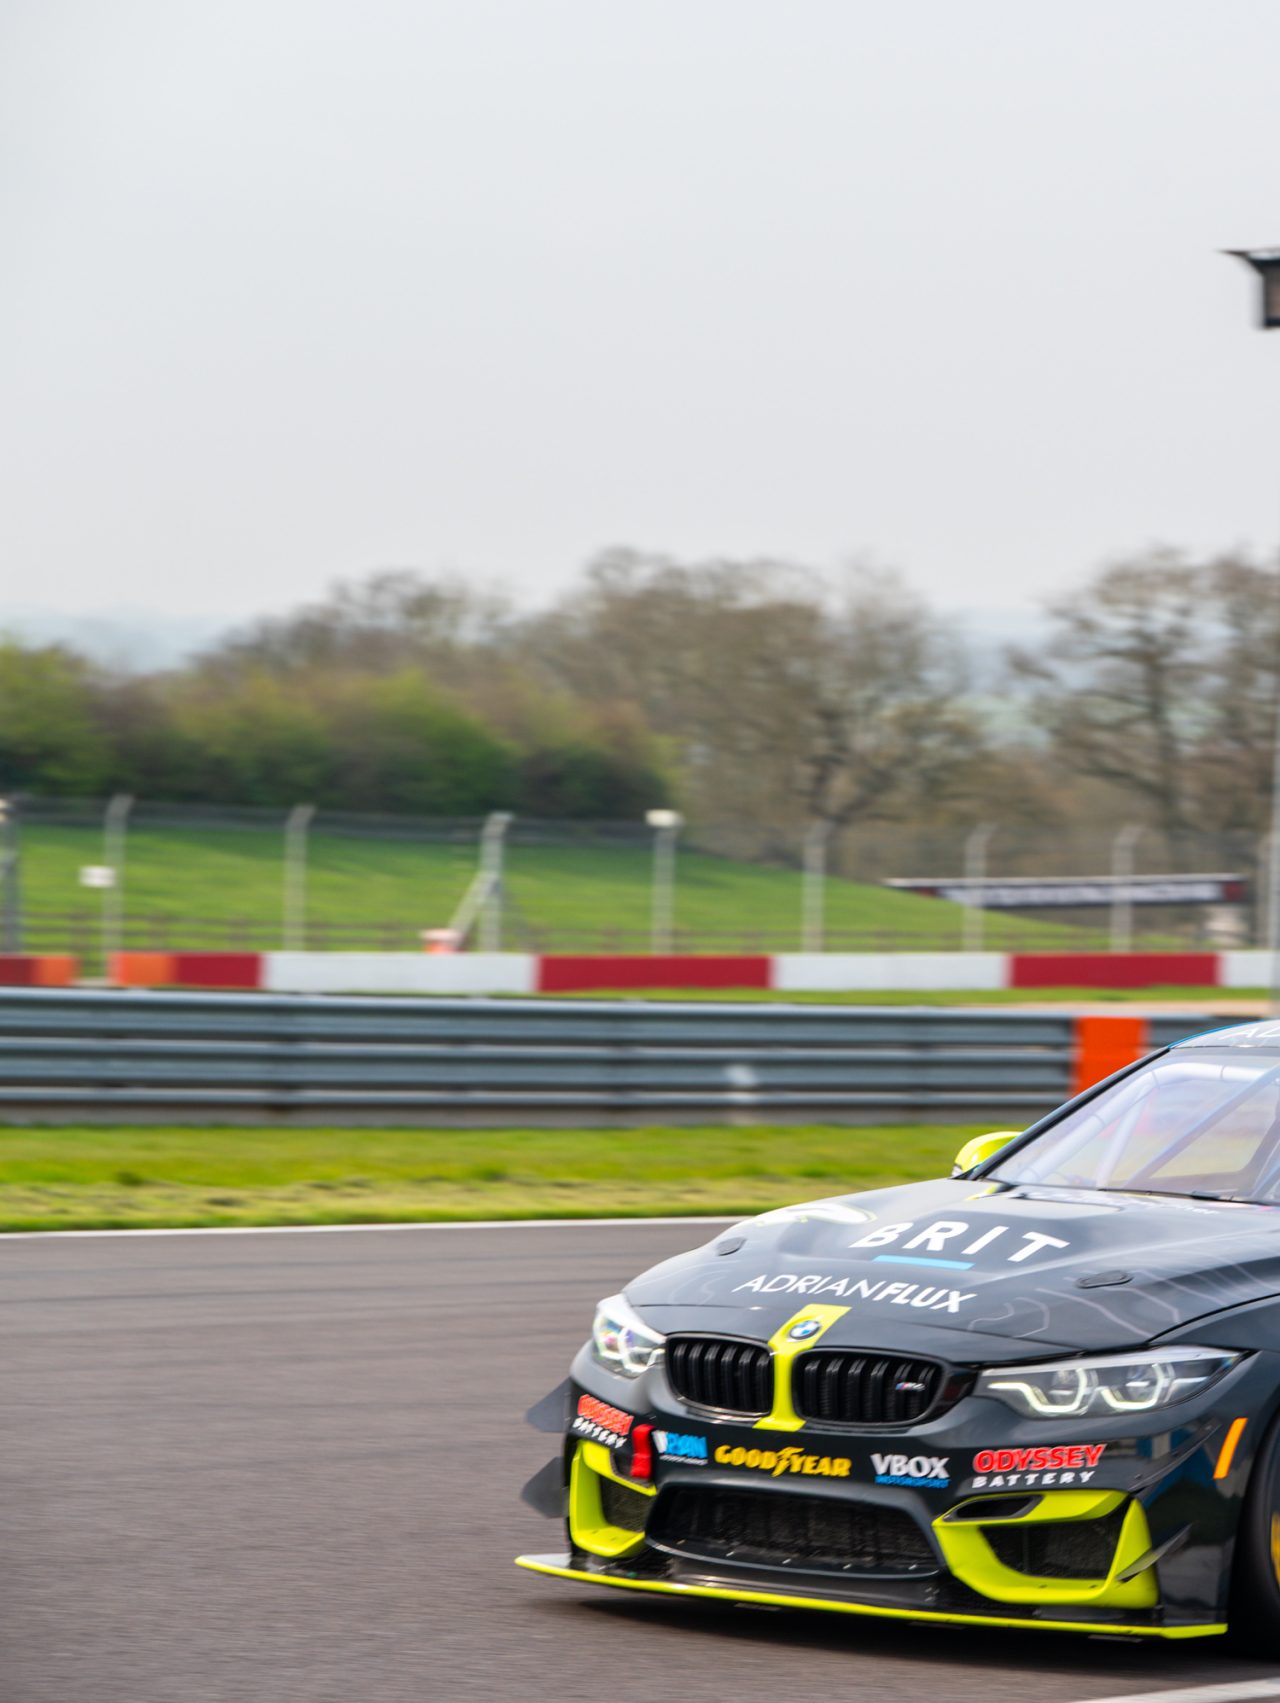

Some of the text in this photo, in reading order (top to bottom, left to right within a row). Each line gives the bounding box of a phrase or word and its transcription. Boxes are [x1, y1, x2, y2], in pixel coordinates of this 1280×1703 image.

[849, 1220, 1070, 1263] BRIT
[732, 1273, 977, 1313] ADRIANFLUX
[714, 1445, 852, 1478] GOODYEAR
[870, 1453, 950, 1479] VBOX
[972, 1443, 1107, 1473] ODYSSEY
[971, 1471, 1095, 1488] BATTERY
